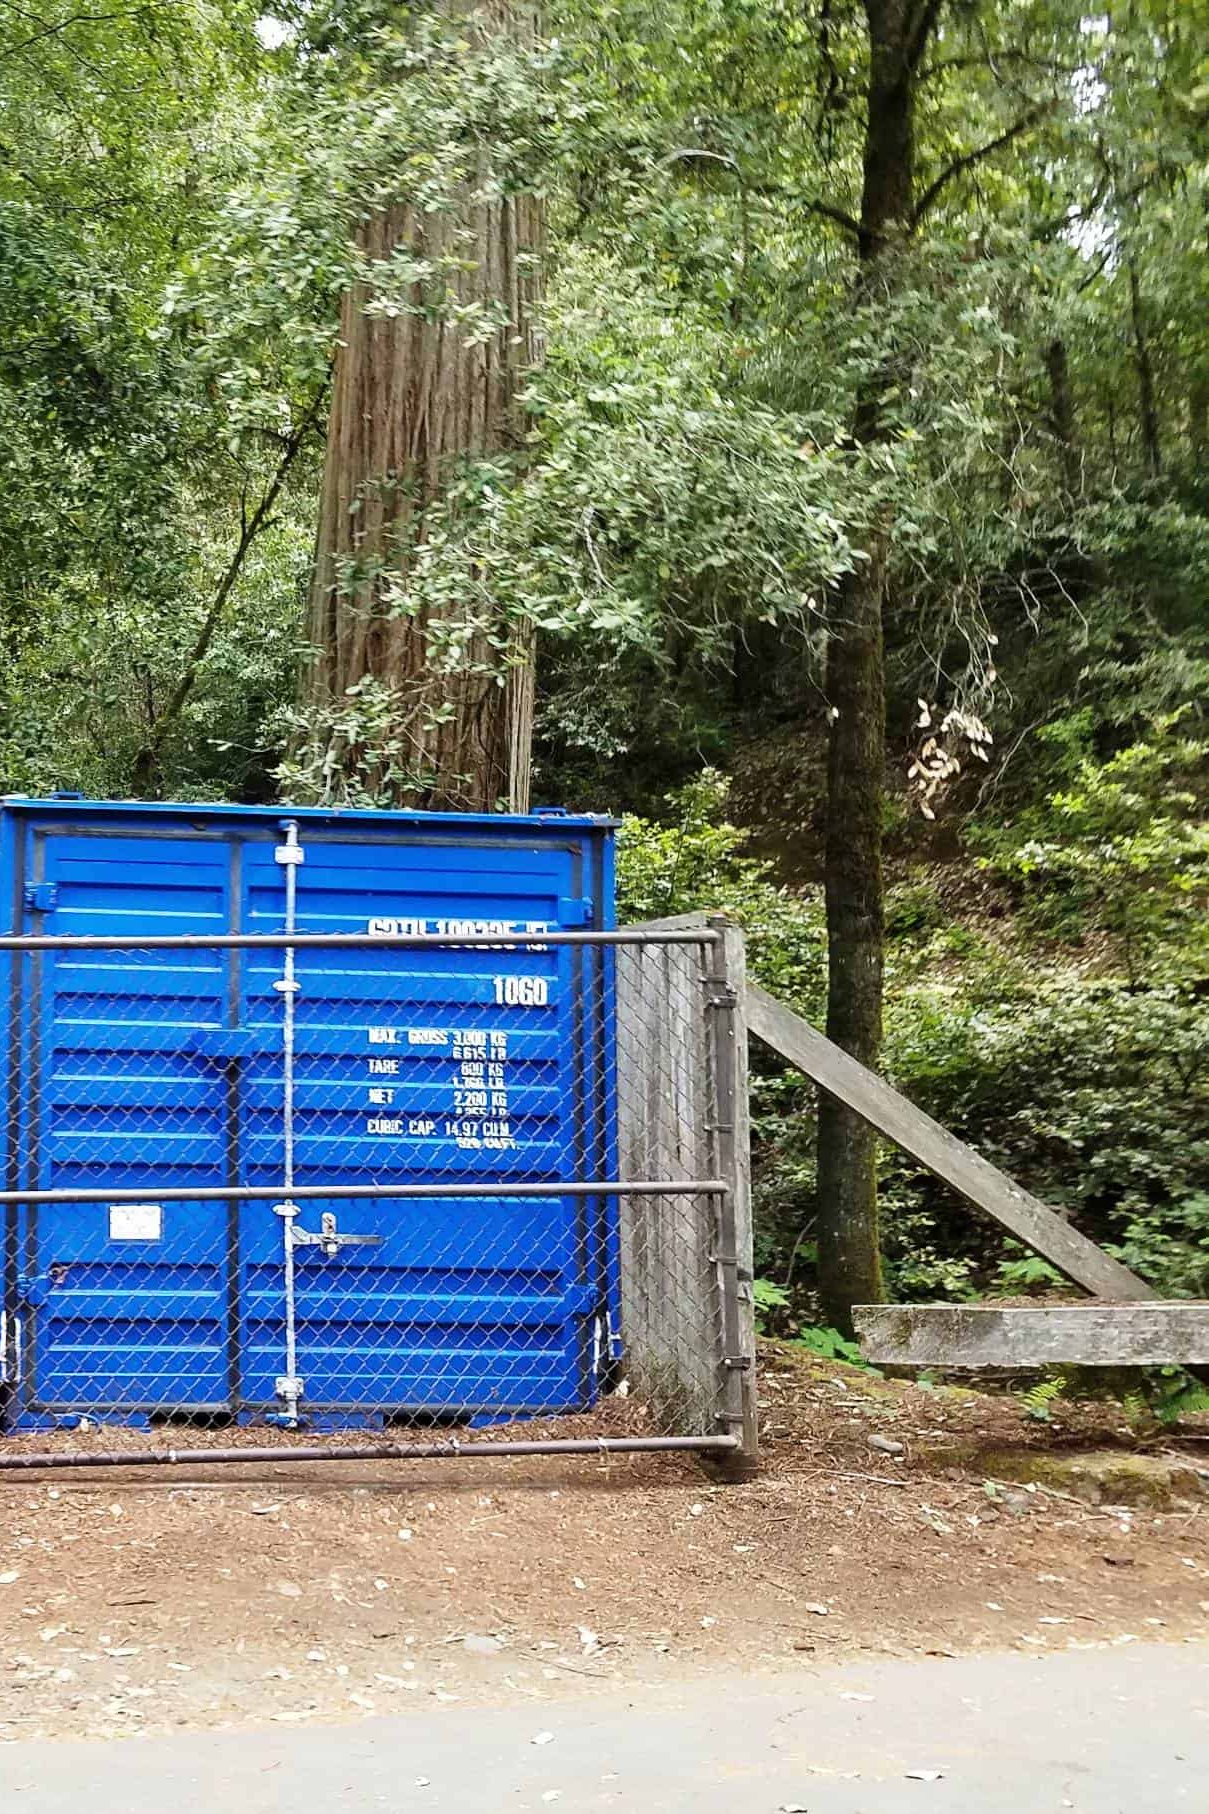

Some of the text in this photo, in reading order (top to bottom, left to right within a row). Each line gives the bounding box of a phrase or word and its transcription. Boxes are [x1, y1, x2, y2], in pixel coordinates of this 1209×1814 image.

[493, 976, 547, 1005] 1060
[369, 1028, 401, 1043] MAX.
[408, 1030, 449, 1045] GROSS
[490, 1031, 508, 1047] KG
[368, 1059, 400, 1074] TARE
[488, 1062, 504, 1077] KG
[369, 1088, 395, 1104] NET
[491, 1091, 508, 1107] KG
[367, 1119, 403, 1135] CUBIC
[408, 1120, 438, 1136] CAP.
